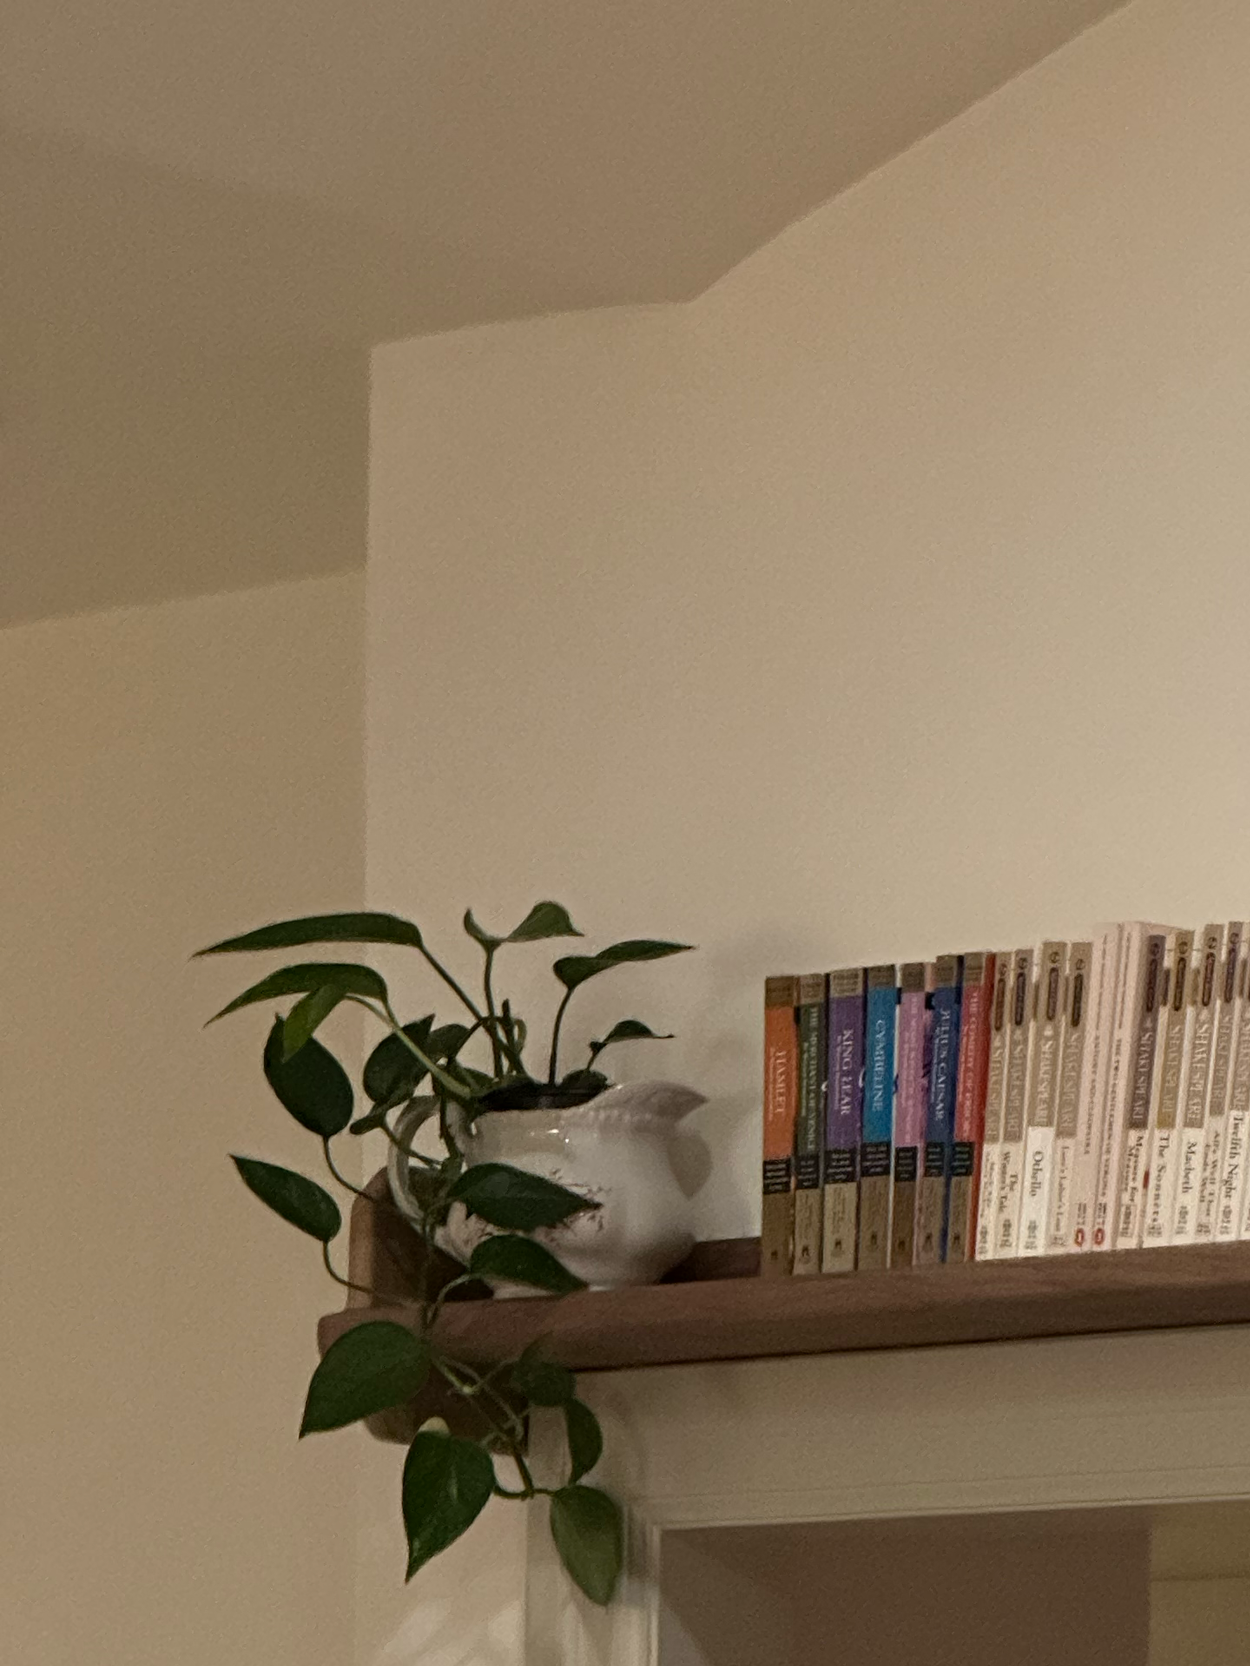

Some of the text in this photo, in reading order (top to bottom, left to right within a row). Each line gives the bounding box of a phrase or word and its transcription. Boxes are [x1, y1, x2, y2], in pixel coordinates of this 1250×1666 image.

[938, 1008, 951, 1058] JULIUS
[840, 1029, 854, 1116] KING LEAR
[872, 1020, 886, 1112] CYMBELINE
[935, 1063, 948, 1121] CAESAR
[1158, 1134, 1170, 1158] The
[1181, 1141, 1198, 1194] Macbeth
[1222, 1117, 1243, 1199] Twelfth Night
[1029, 1151, 1044, 1197] Othello
